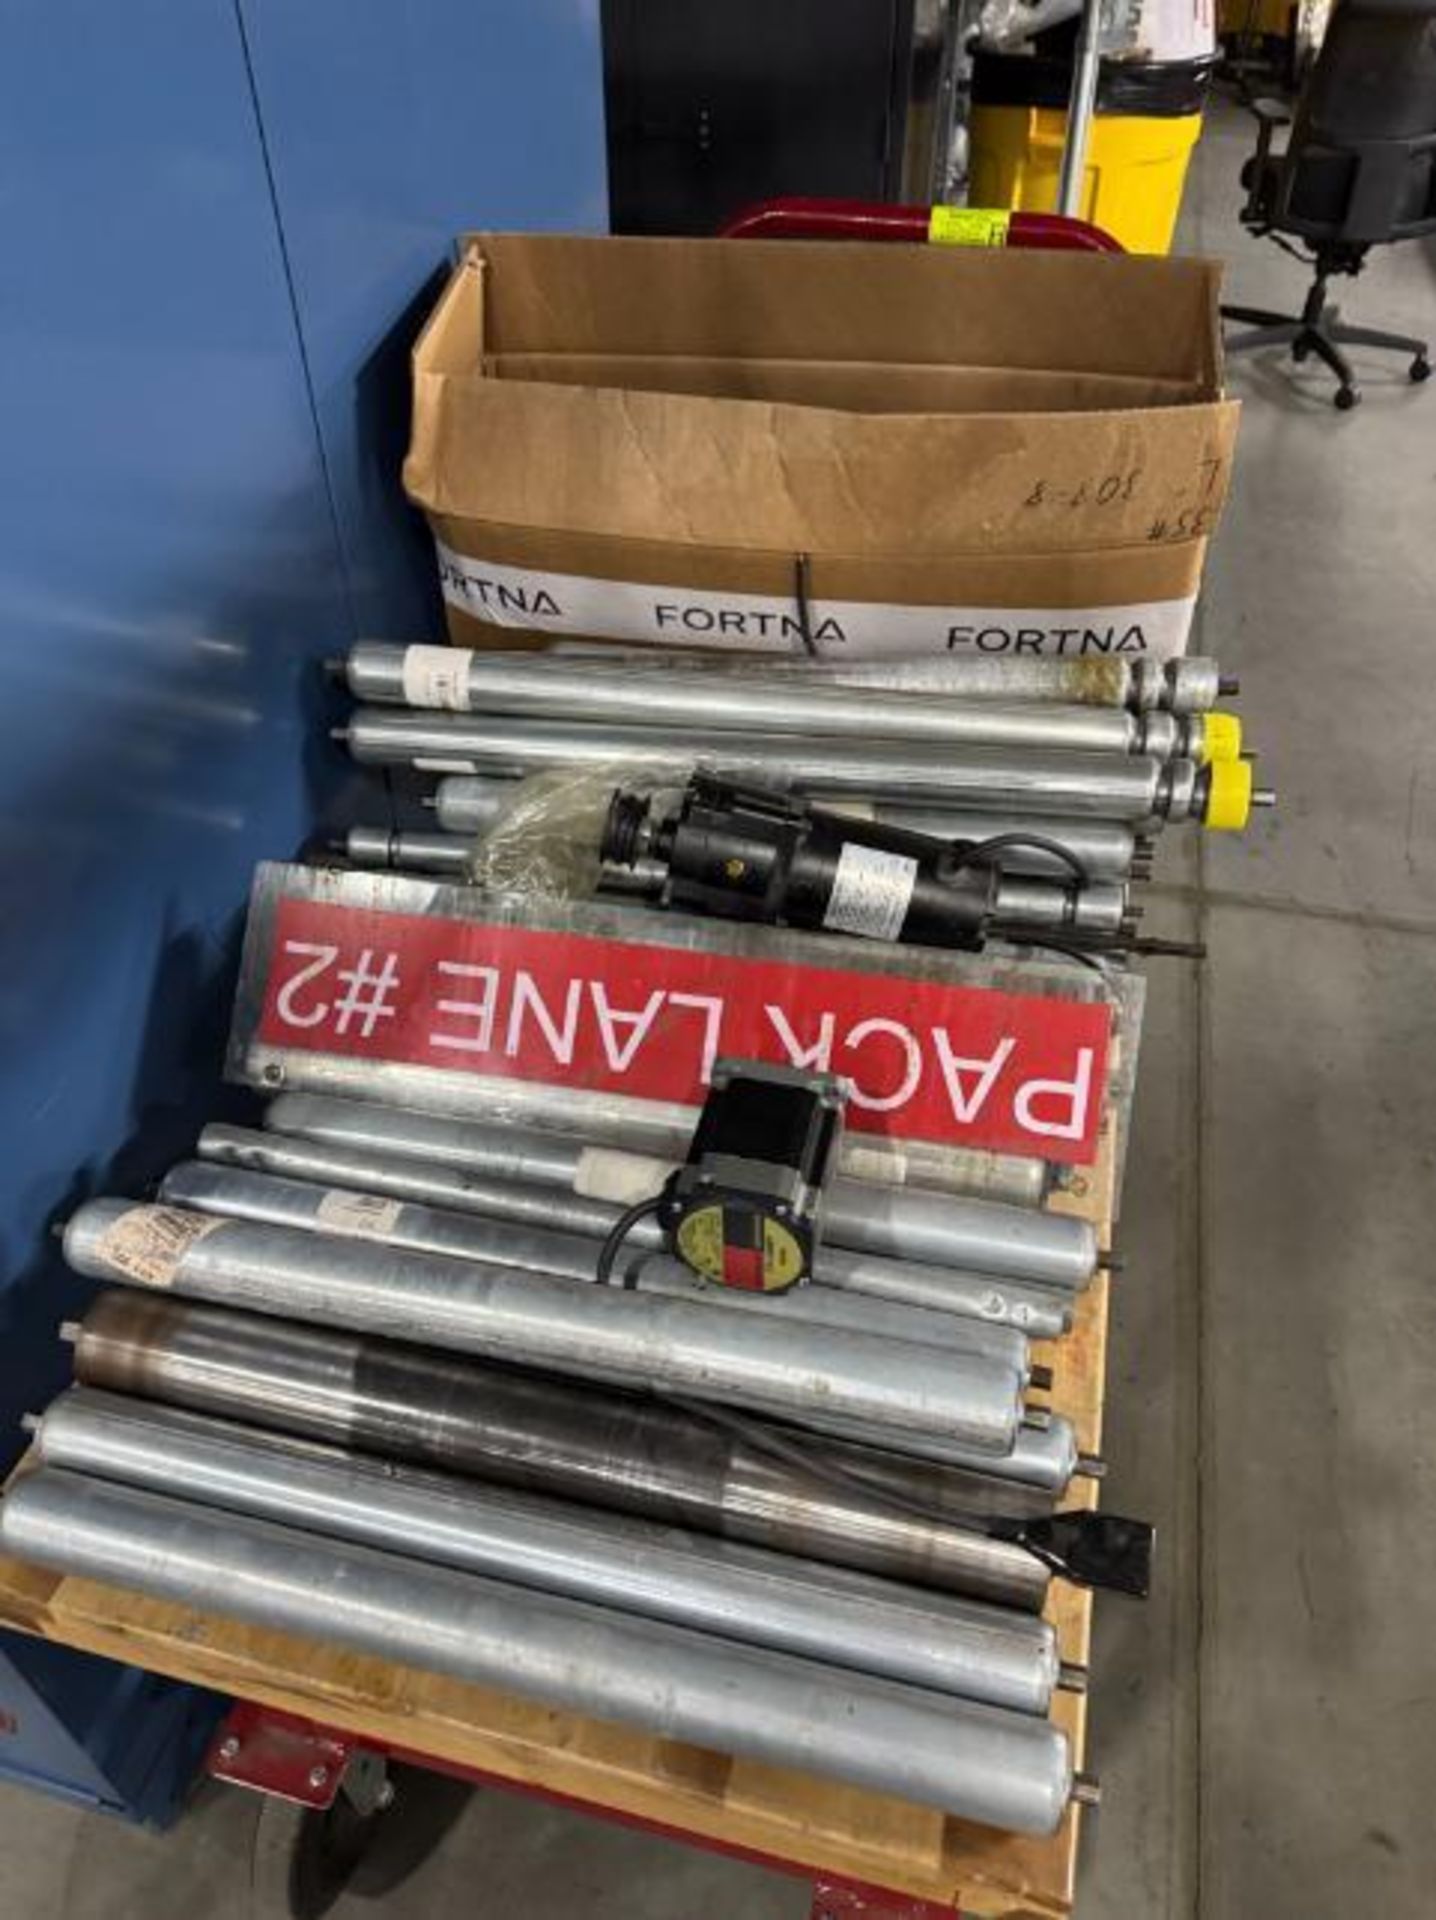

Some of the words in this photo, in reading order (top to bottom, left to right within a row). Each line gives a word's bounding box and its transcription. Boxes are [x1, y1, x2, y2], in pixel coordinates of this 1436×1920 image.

[947, 624, 1148, 655] FORTNA
[276, 940, 400, 1038] #2
[428, 960, 724, 1085] LANE
[763, 1003, 1095, 1140] PACK
